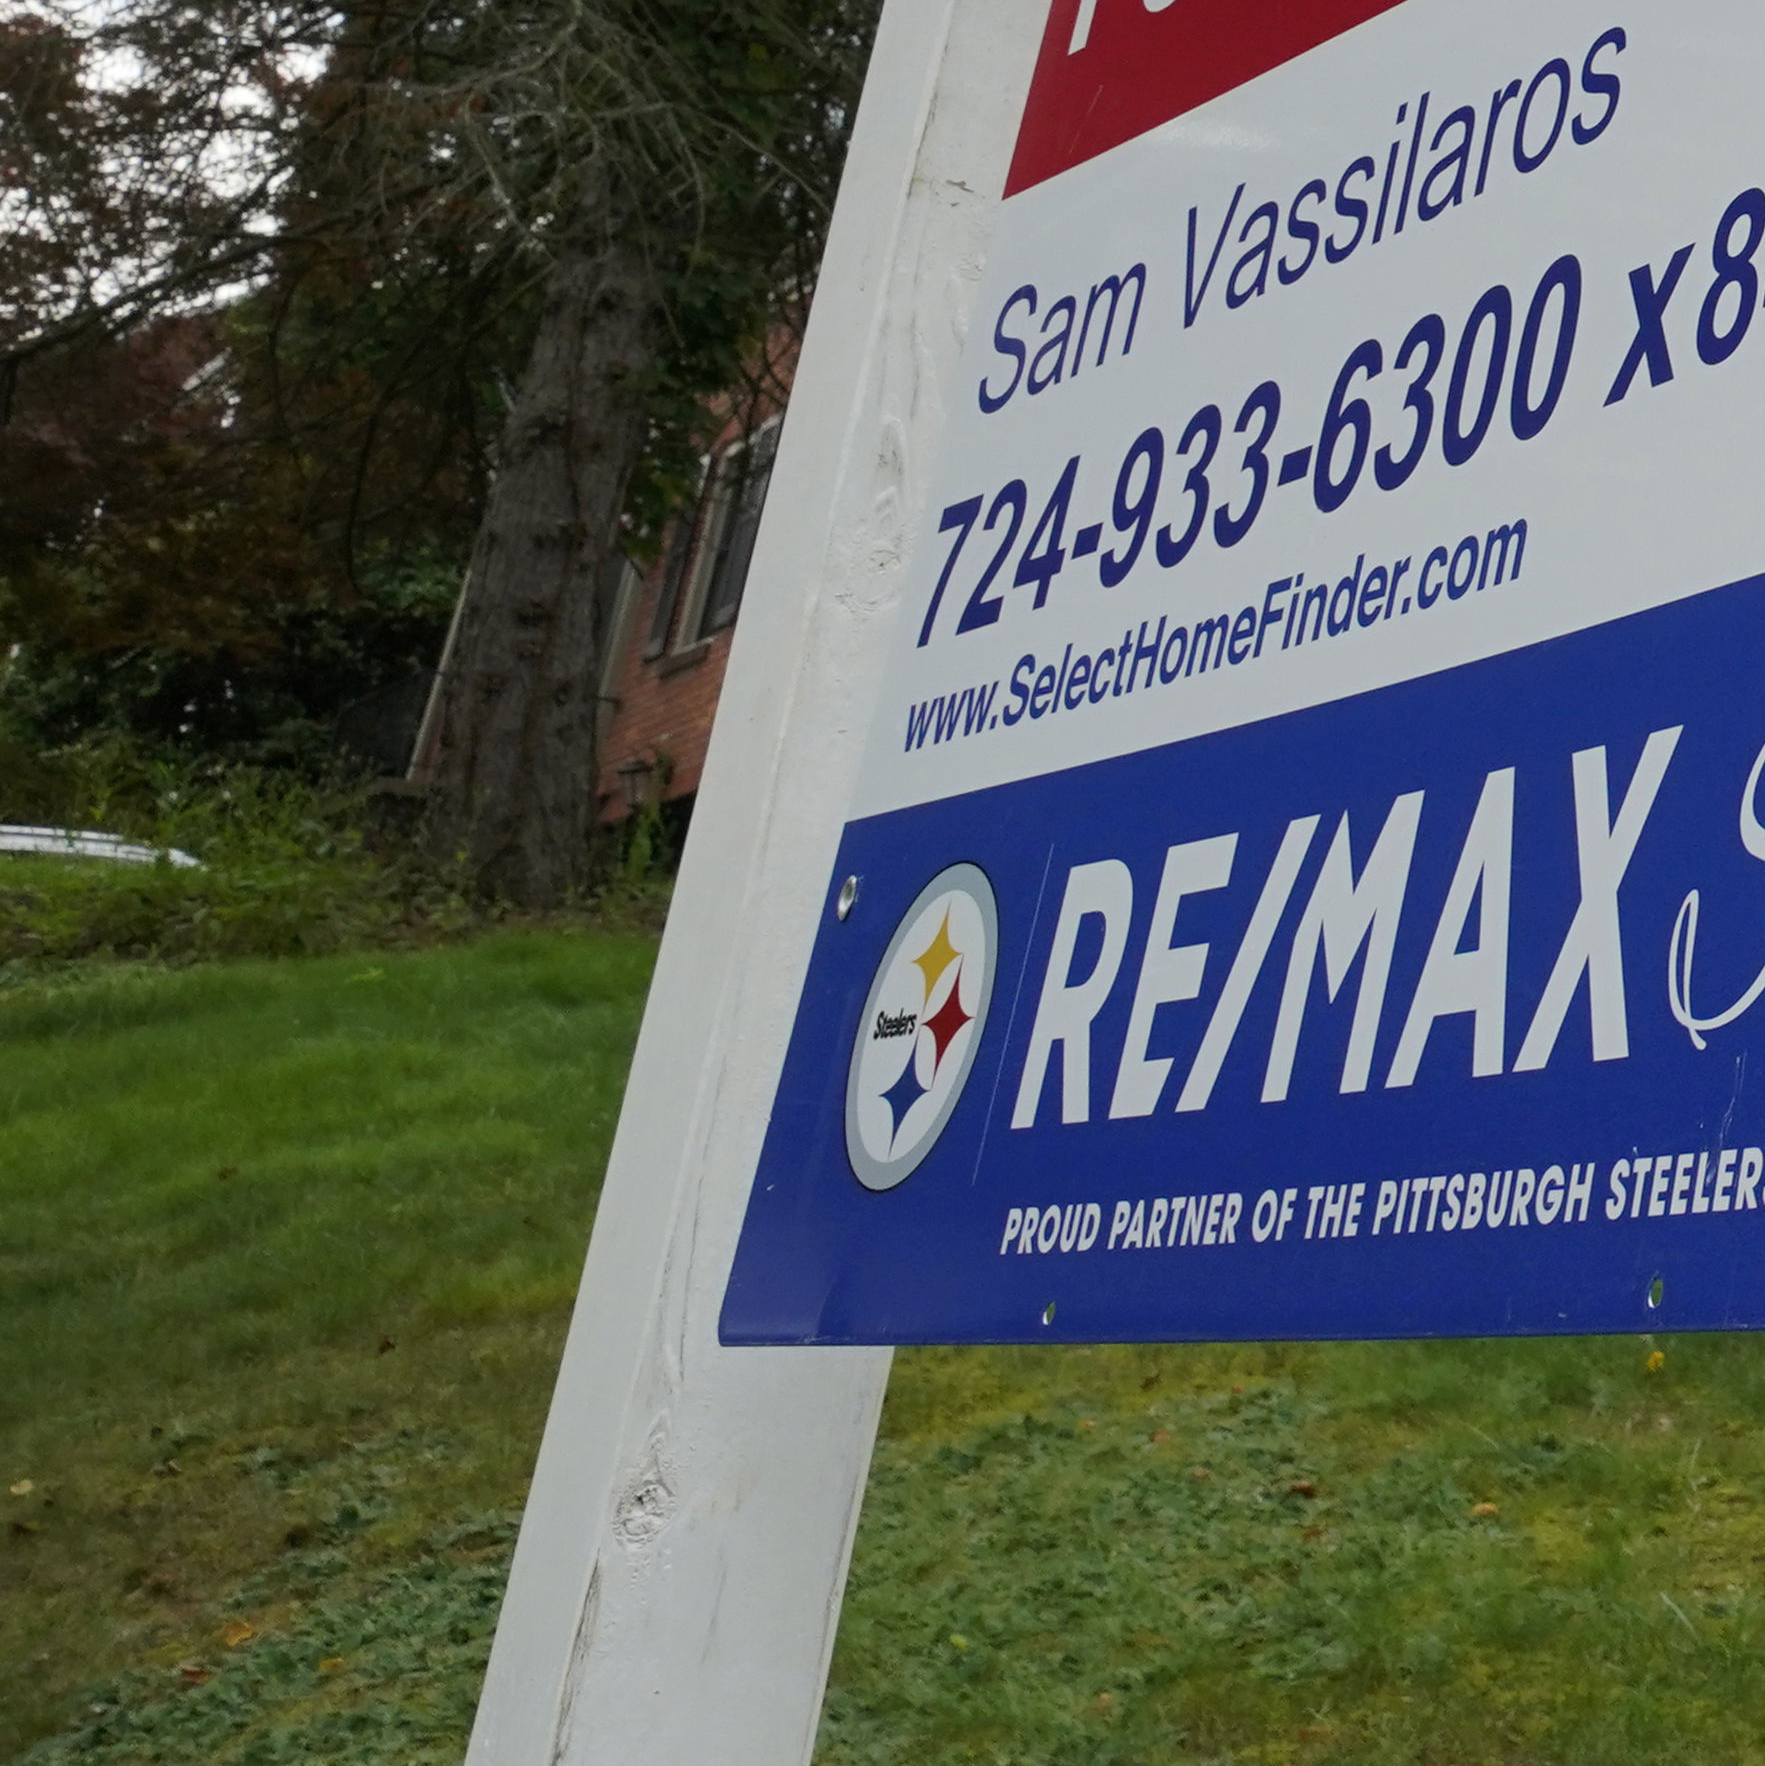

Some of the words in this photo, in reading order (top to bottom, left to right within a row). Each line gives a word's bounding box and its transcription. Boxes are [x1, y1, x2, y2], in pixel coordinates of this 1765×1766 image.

[979, 262, 1146, 413] Sam
[1182, 26, 1628, 330] Vassilaros
[916, 252, 1582, 648] 724-933-6300
[903, 517, 1528, 753] www.SelectHomeFinder.com
[873, 1007, 918, 1041] Steelers
[1010, 724, 1684, 1130] RE/MAX
[1000, 1202, 1104, 1255] PROUD
[1107, 1191, 1243, 1251] PARTNER
[1250, 1186, 1297, 1244] OF
[1304, 1180, 1366, 1240] THE
[1372, 1161, 1596, 1236] PITTSBURGH
